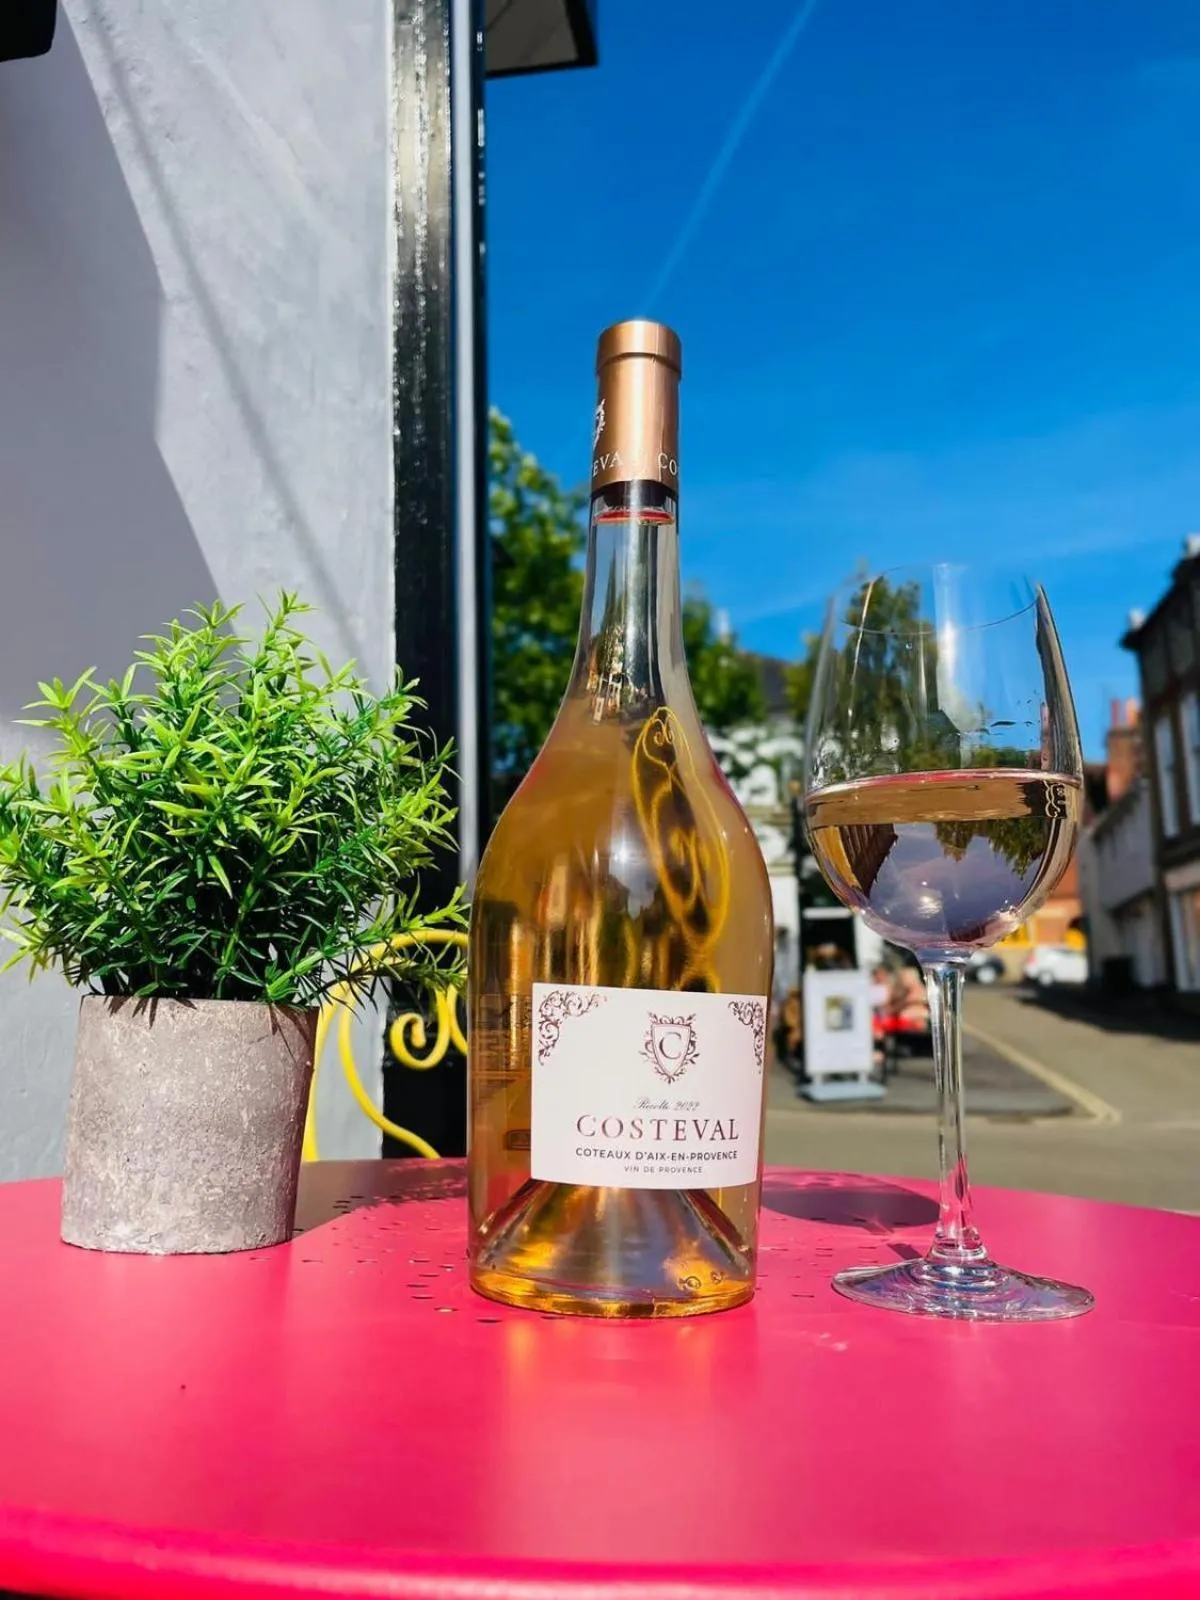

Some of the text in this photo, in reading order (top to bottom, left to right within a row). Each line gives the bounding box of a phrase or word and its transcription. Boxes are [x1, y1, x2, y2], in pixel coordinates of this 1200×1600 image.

[658, 1031, 682, 1060] C
[576, 1114, 739, 1142] COSTEVAL
[575, 1147, 738, 1162] COTEAUX D'AIX-EN-PROVENCE
[643, 1166, 655, 1174] DE
[658, 1166, 703, 1174] PROVENCE
